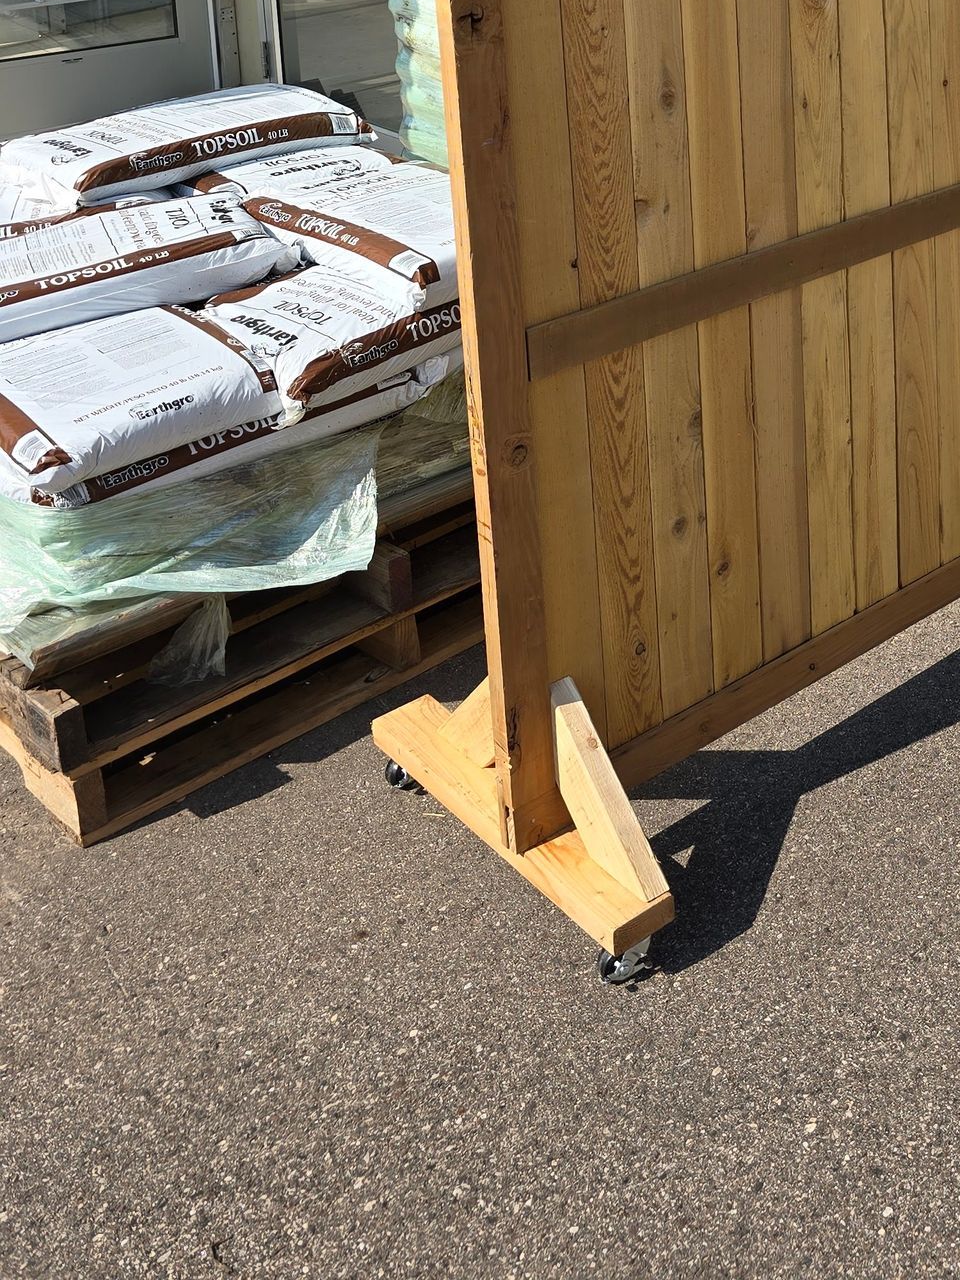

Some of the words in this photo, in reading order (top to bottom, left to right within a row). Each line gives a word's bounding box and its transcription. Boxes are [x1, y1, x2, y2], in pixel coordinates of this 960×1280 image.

[135, 152, 184, 170] Earthgro
[192, 128, 264, 156] TOPSOIL
[267, 131, 277, 140] 40
[278, 129, 289, 138] LB
[23, 225, 36, 234] 40
[259, 206, 292, 222] Earthgro
[295, 214, 345, 240] TOPSOIL
[340, 234, 349, 242] 40
[350, 236, 359, 246] LB
[35, 259, 133, 290] TOPSOIL
[138, 254, 152, 264] 40
[153, 250, 170, 260] LB
[273, 300, 333, 326] TOPSOIL
[406, 304, 460, 342] TOPSO
[230, 315, 299, 346] Earthgro
[350, 339, 399, 367] Earthgro
[73, 415, 90, 424] NET
[136, 394, 194, 420] Earthgro
[102, 455, 169, 489] Earthgro
